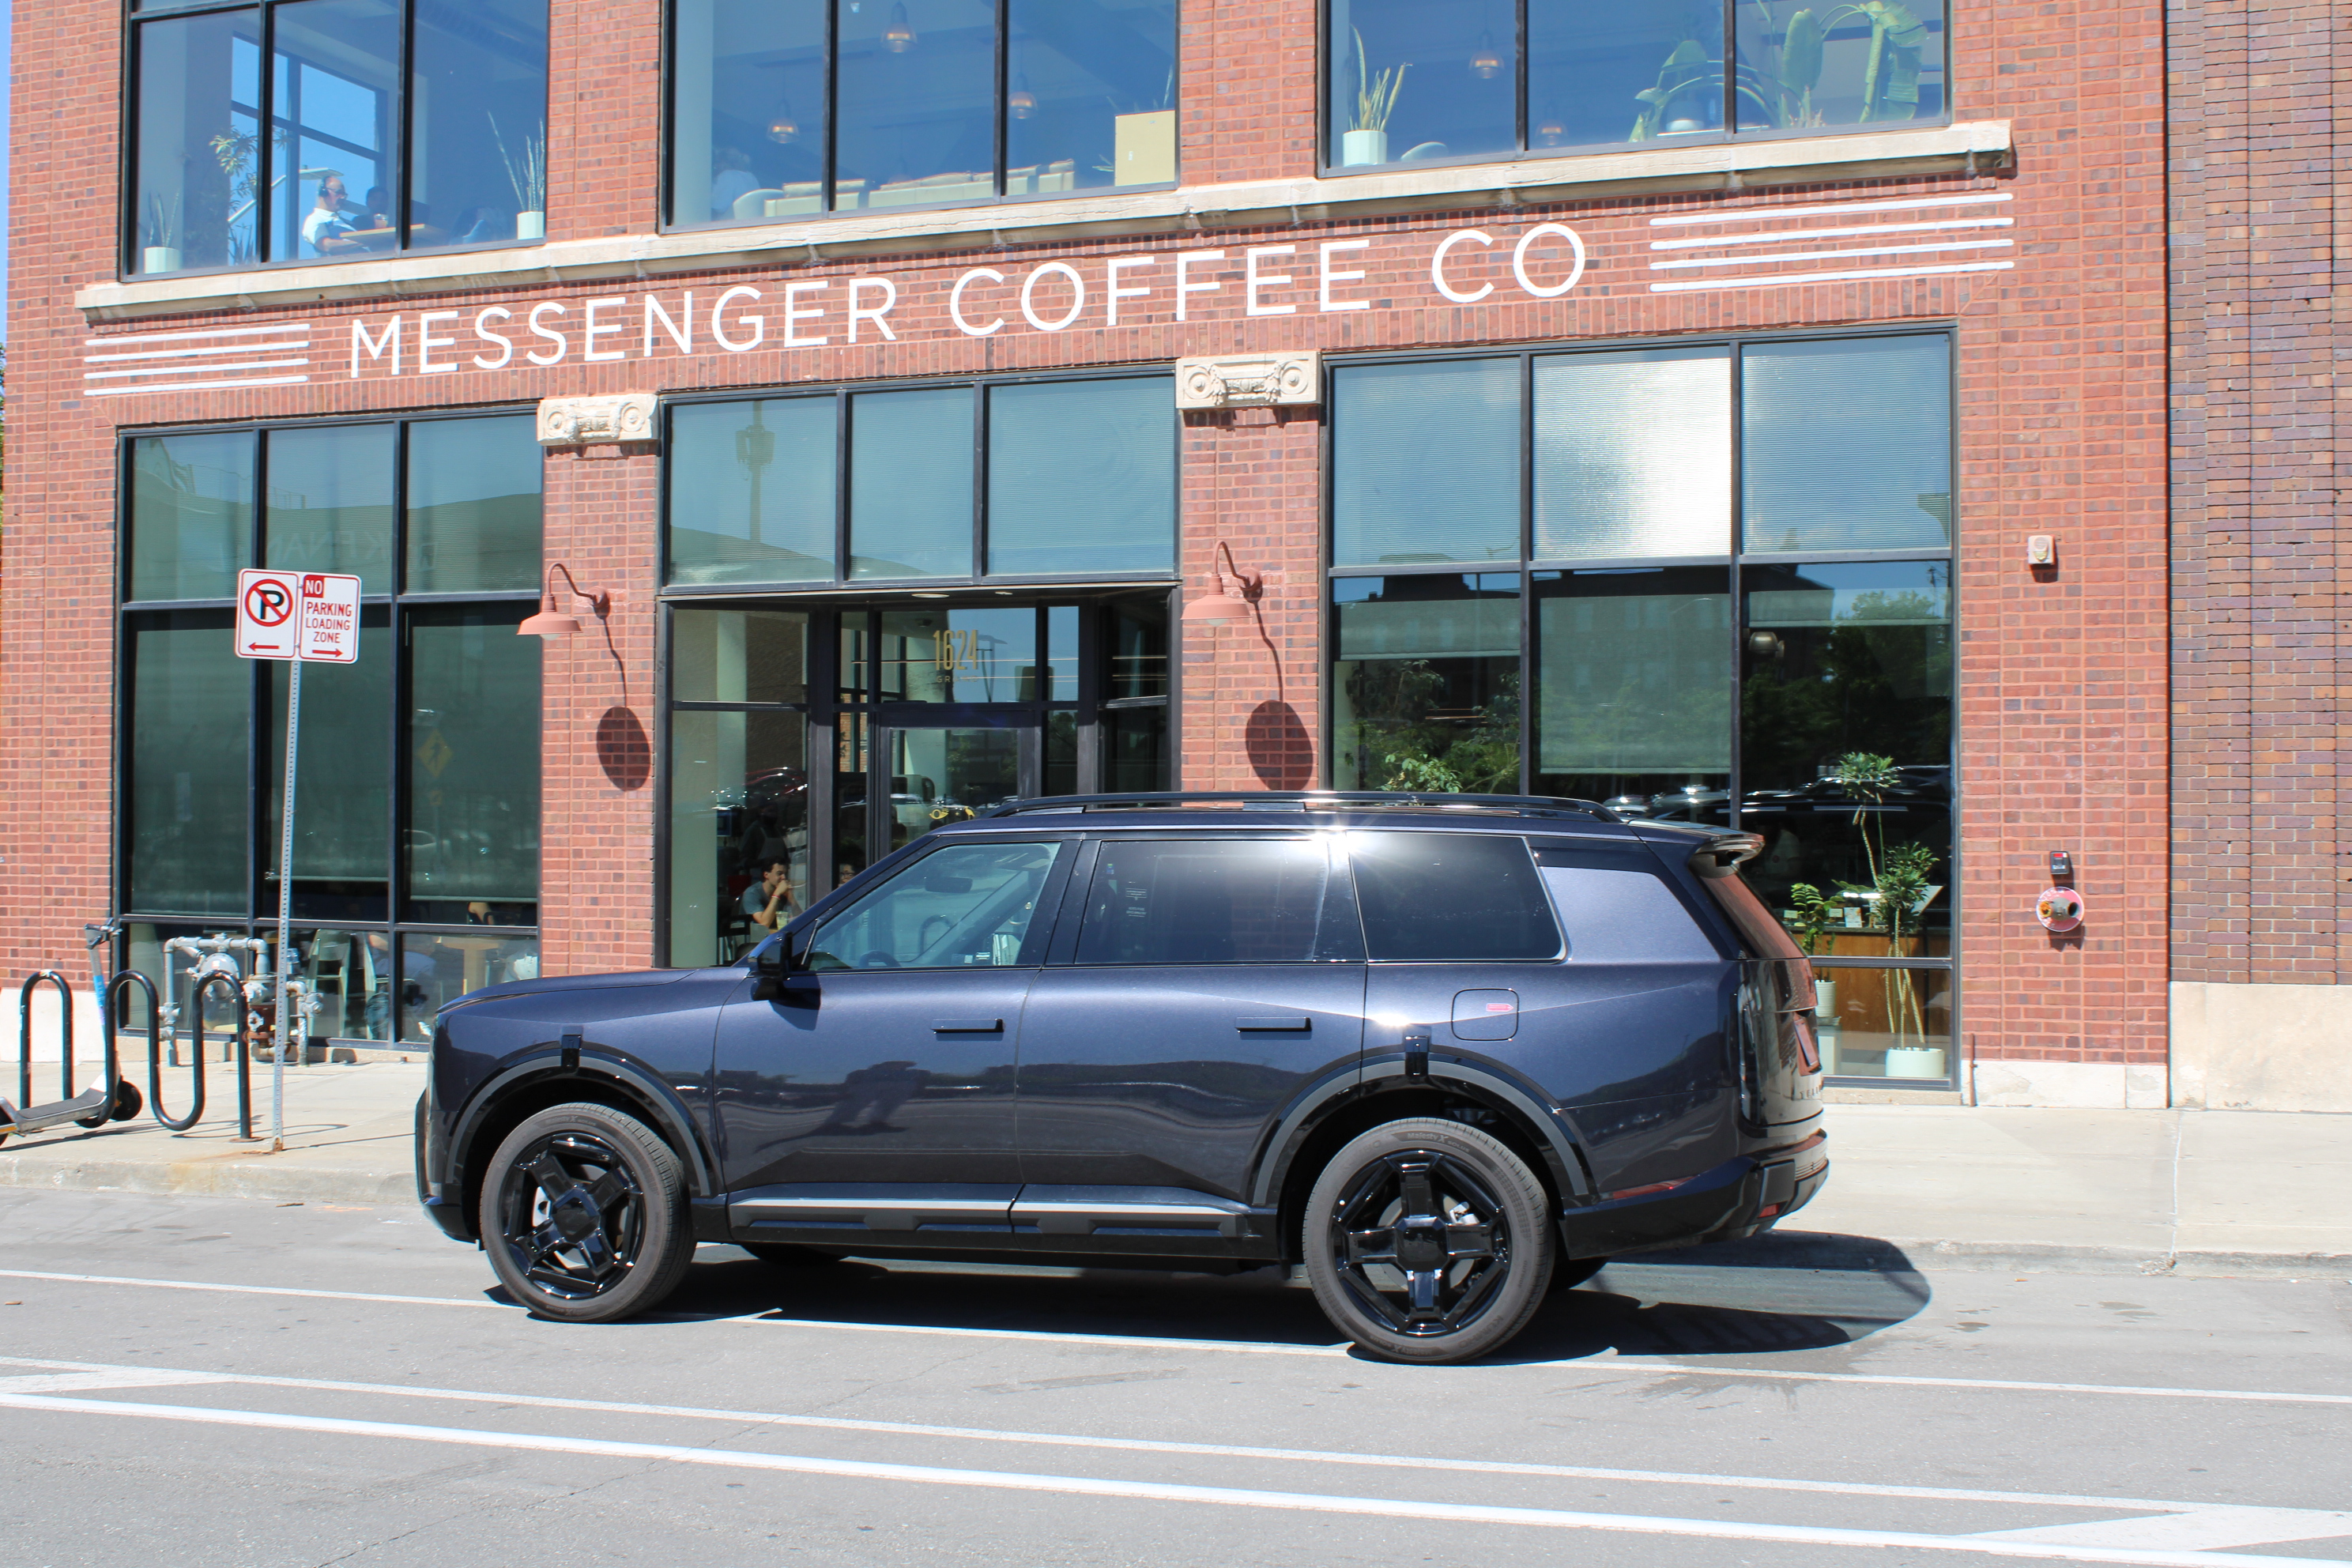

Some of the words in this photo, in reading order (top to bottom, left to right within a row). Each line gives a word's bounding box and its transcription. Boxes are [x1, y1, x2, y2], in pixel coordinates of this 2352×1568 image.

[349, 277, 898, 379] MESSENGER
[949, 238, 1370, 337] COFFEE
[1431, 223, 1586, 303] CO
[305, 579, 323, 595] NO
[306, 601, 352, 617] PARKING
[306, 617, 351, 631] LOADING
[313, 631, 341, 643] ZONE
[933, 630, 978, 670] 1624
